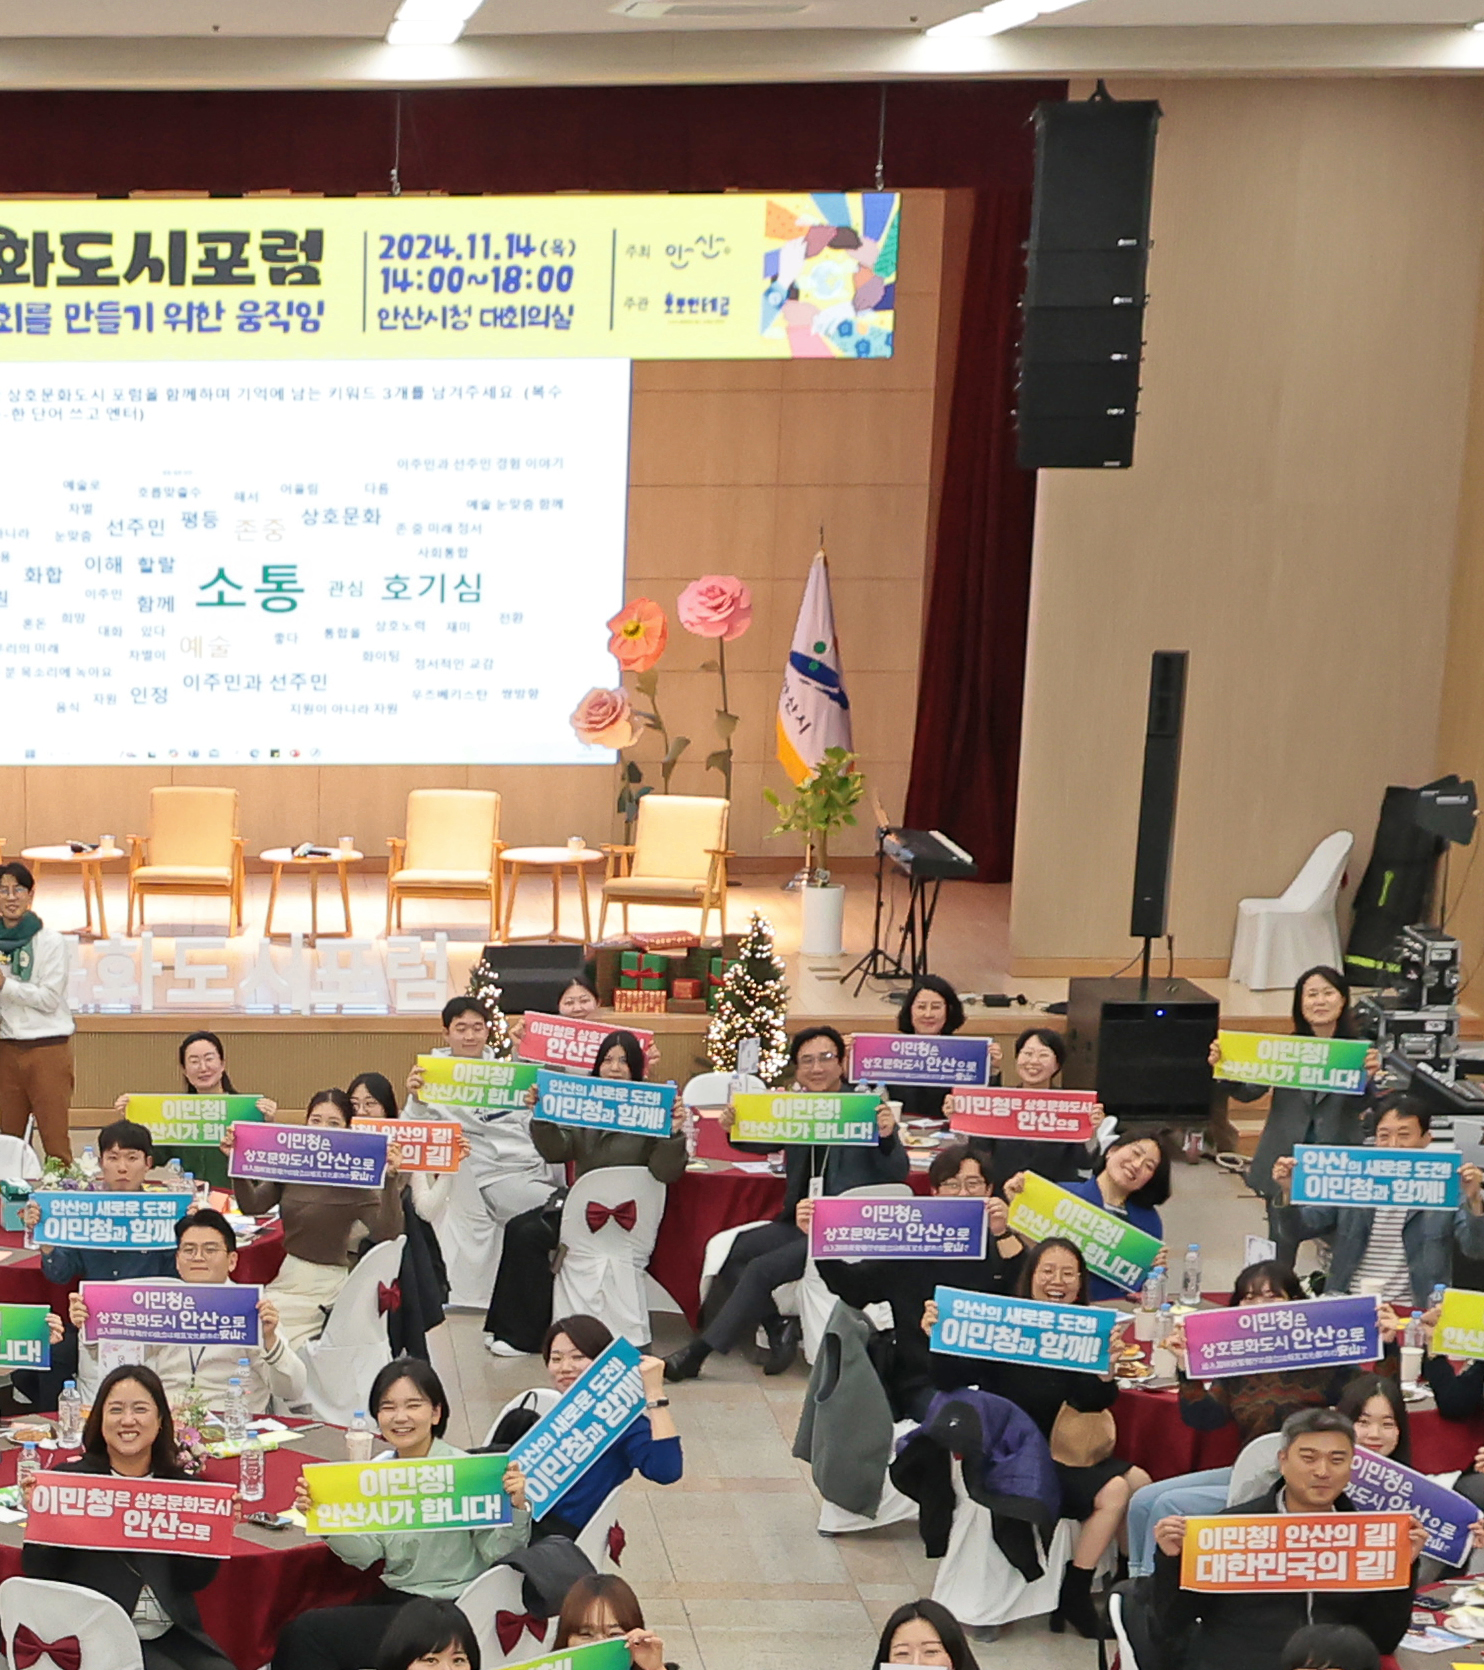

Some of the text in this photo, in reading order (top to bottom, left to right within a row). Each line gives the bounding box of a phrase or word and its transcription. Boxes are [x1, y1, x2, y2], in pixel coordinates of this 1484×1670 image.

[380, 265, 574, 293] 14:00~18:00
[64, 301, 154, 335] 만들기
[164, 300, 225, 334] 위한
[237, 300, 325, 335] 움직임
[378, 304, 574, 331] 안산시청 대회의실
[106, 517, 165, 538] 선주민
[181, 510, 219, 530] 평등
[301, 507, 382, 527] 상호문화
[24, 565, 63, 585] 화합
[85, 555, 124, 575] 이해
[196, 564, 305, 613] 소통
[381, 572, 483, 604] 호기심
[137, 595, 175, 614] 함께
[130, 685, 169, 706] 인정
[183, 672, 328, 693] 이주민과 선주민
[772, 1097, 840, 1120] 이민청!
[814, 1120, 873, 1141] 합니다!
[1303, 1150, 1362, 1174] 안산의
[1364, 1157, 1413, 1177] 새로운
[1305, 1174, 1446, 1205] 이민청과 함께!
[132, 1291, 195, 1311] 이민청은
[97, 1310, 247, 1330] 상호문화도시 안산으로
[359, 1463, 455, 1498] 이민청!
[32, 1484, 232, 1517] 이민청은 상호문화도시
[316, 1495, 502, 1529] 안산시가 합니다!
[123, 1509, 211, 1542] 안산으로
[1197, 1522, 1396, 1551] 이민청! 안산의 길!
[1196, 1549, 1396, 1583] 대한민국의 길!
